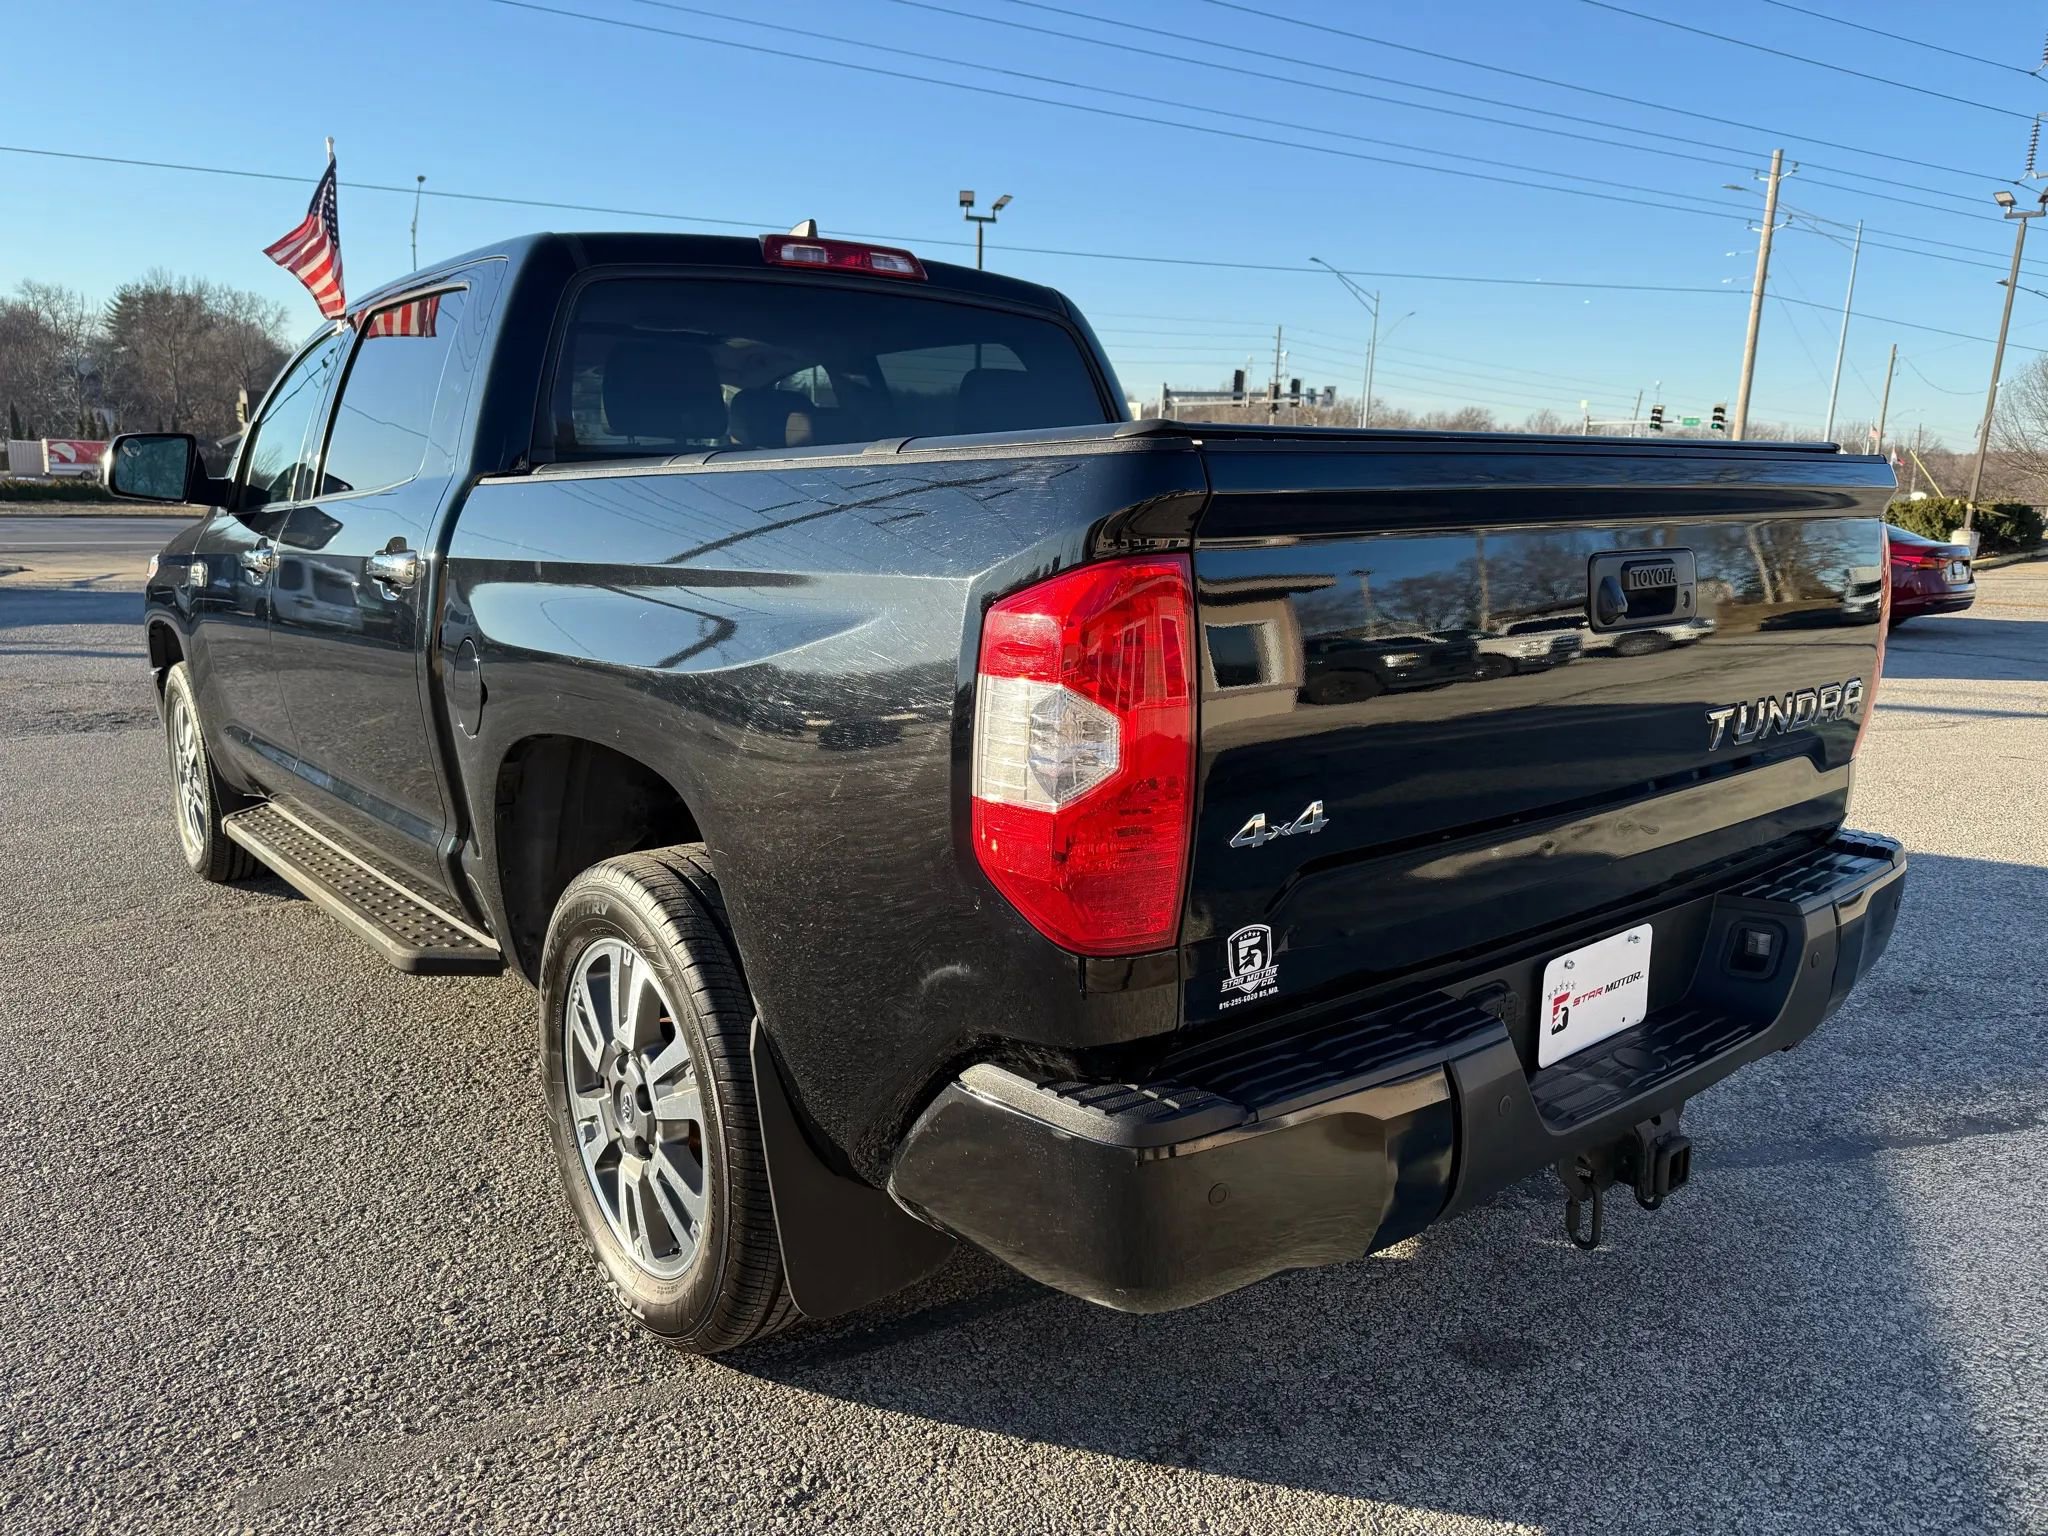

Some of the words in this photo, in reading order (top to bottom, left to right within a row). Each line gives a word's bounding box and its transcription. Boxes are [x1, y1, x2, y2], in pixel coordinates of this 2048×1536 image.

[1631, 567, 1678, 588] TOYOTA
[1705, 676, 1865, 752] TUNDRA
[1229, 799, 1330, 849] 4x4
[557, 900, 610, 939] COUNTRY
[1221, 977, 1244, 990] STAR
[1246, 967, 1278, 983] MOTOR
[1572, 986, 1604, 1008] STAR
[1604, 970, 1641, 992] MOTOR
